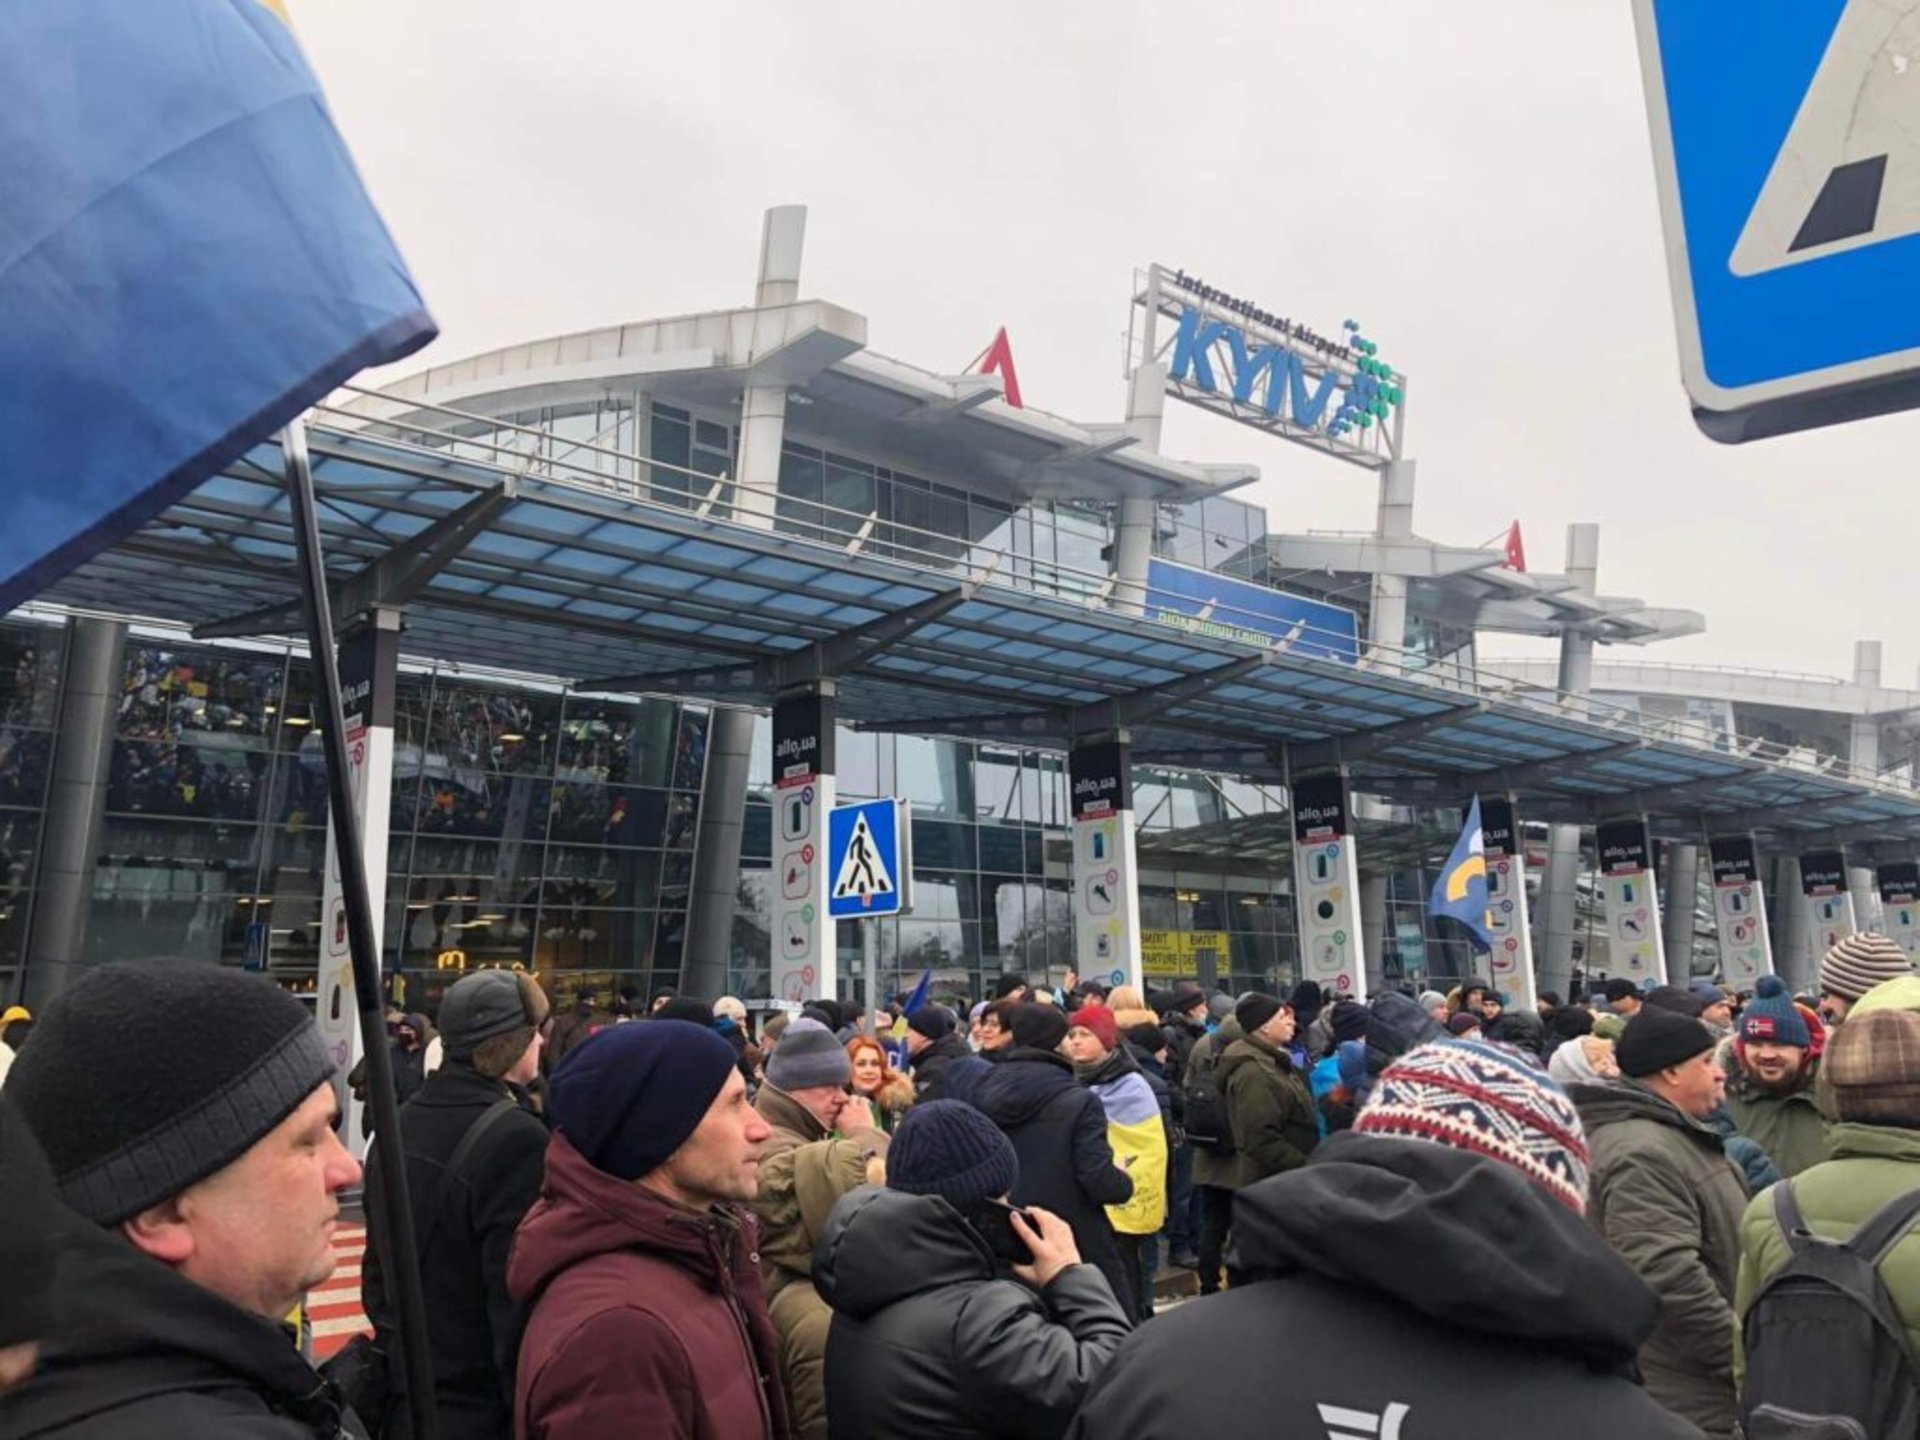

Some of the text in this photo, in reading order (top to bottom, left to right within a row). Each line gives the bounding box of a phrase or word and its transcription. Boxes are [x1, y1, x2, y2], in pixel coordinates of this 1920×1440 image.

[1174, 269, 1350, 361] International Airport
[1171, 307, 1339, 429] KYIV
[776, 736, 817, 758] allo.ua
[1074, 777, 1117, 796] allo.ua
[1297, 806, 1339, 822] allo.ua
